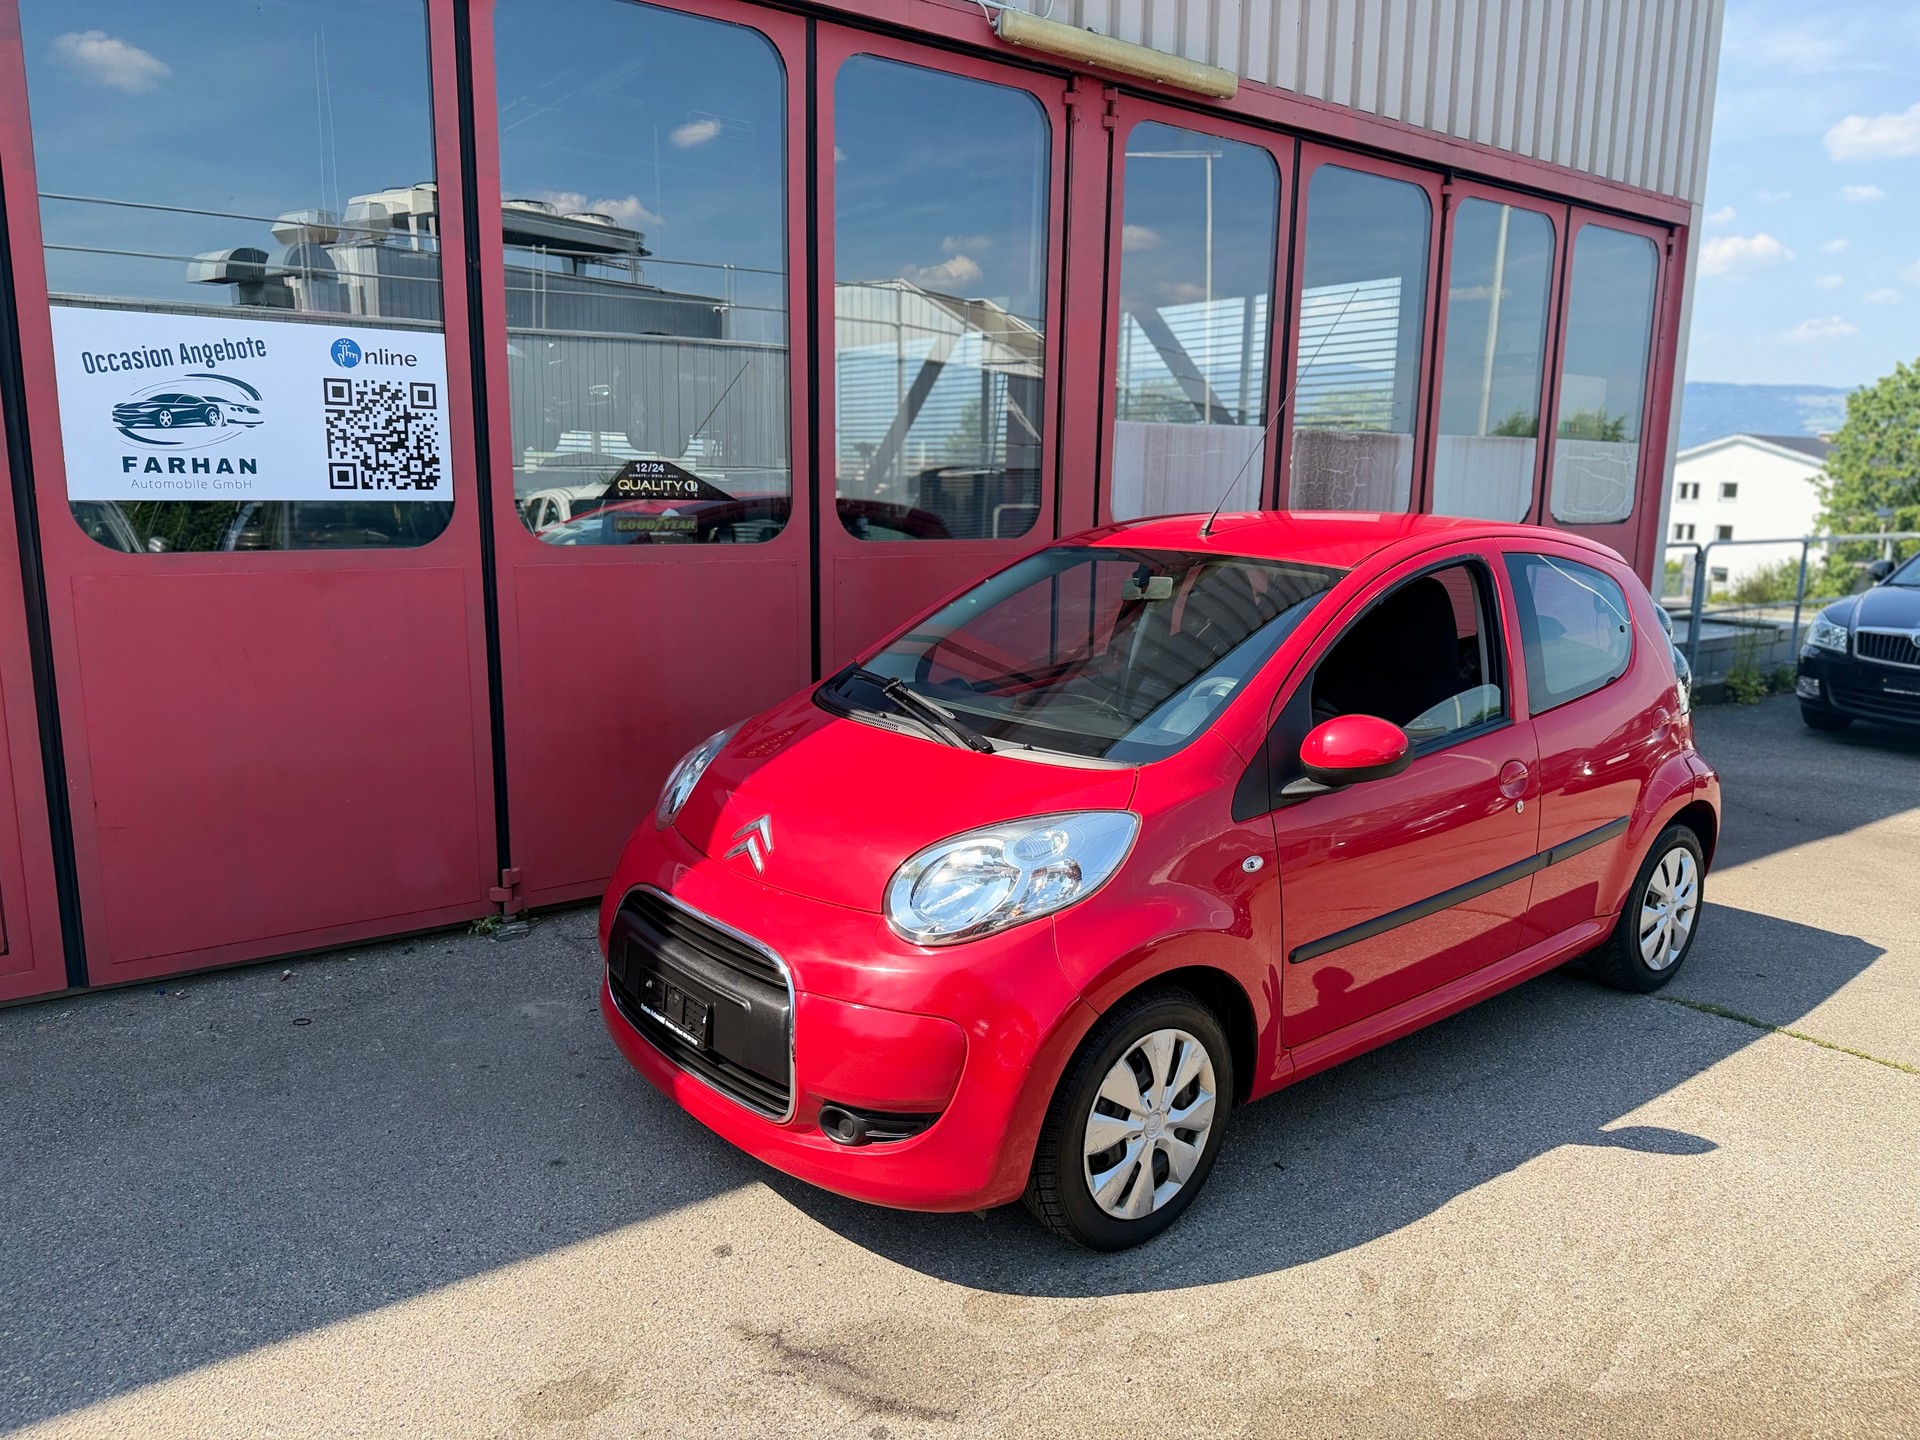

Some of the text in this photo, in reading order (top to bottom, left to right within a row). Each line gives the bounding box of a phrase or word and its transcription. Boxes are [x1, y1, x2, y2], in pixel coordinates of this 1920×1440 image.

[81, 336, 267, 374] Occasion Angebote
[121, 455, 258, 475] FARHAN
[635, 462, 665, 473] 12/24
[130, 478, 253, 490] Automobile GmbH
[617, 479, 683, 491] QUALITY
